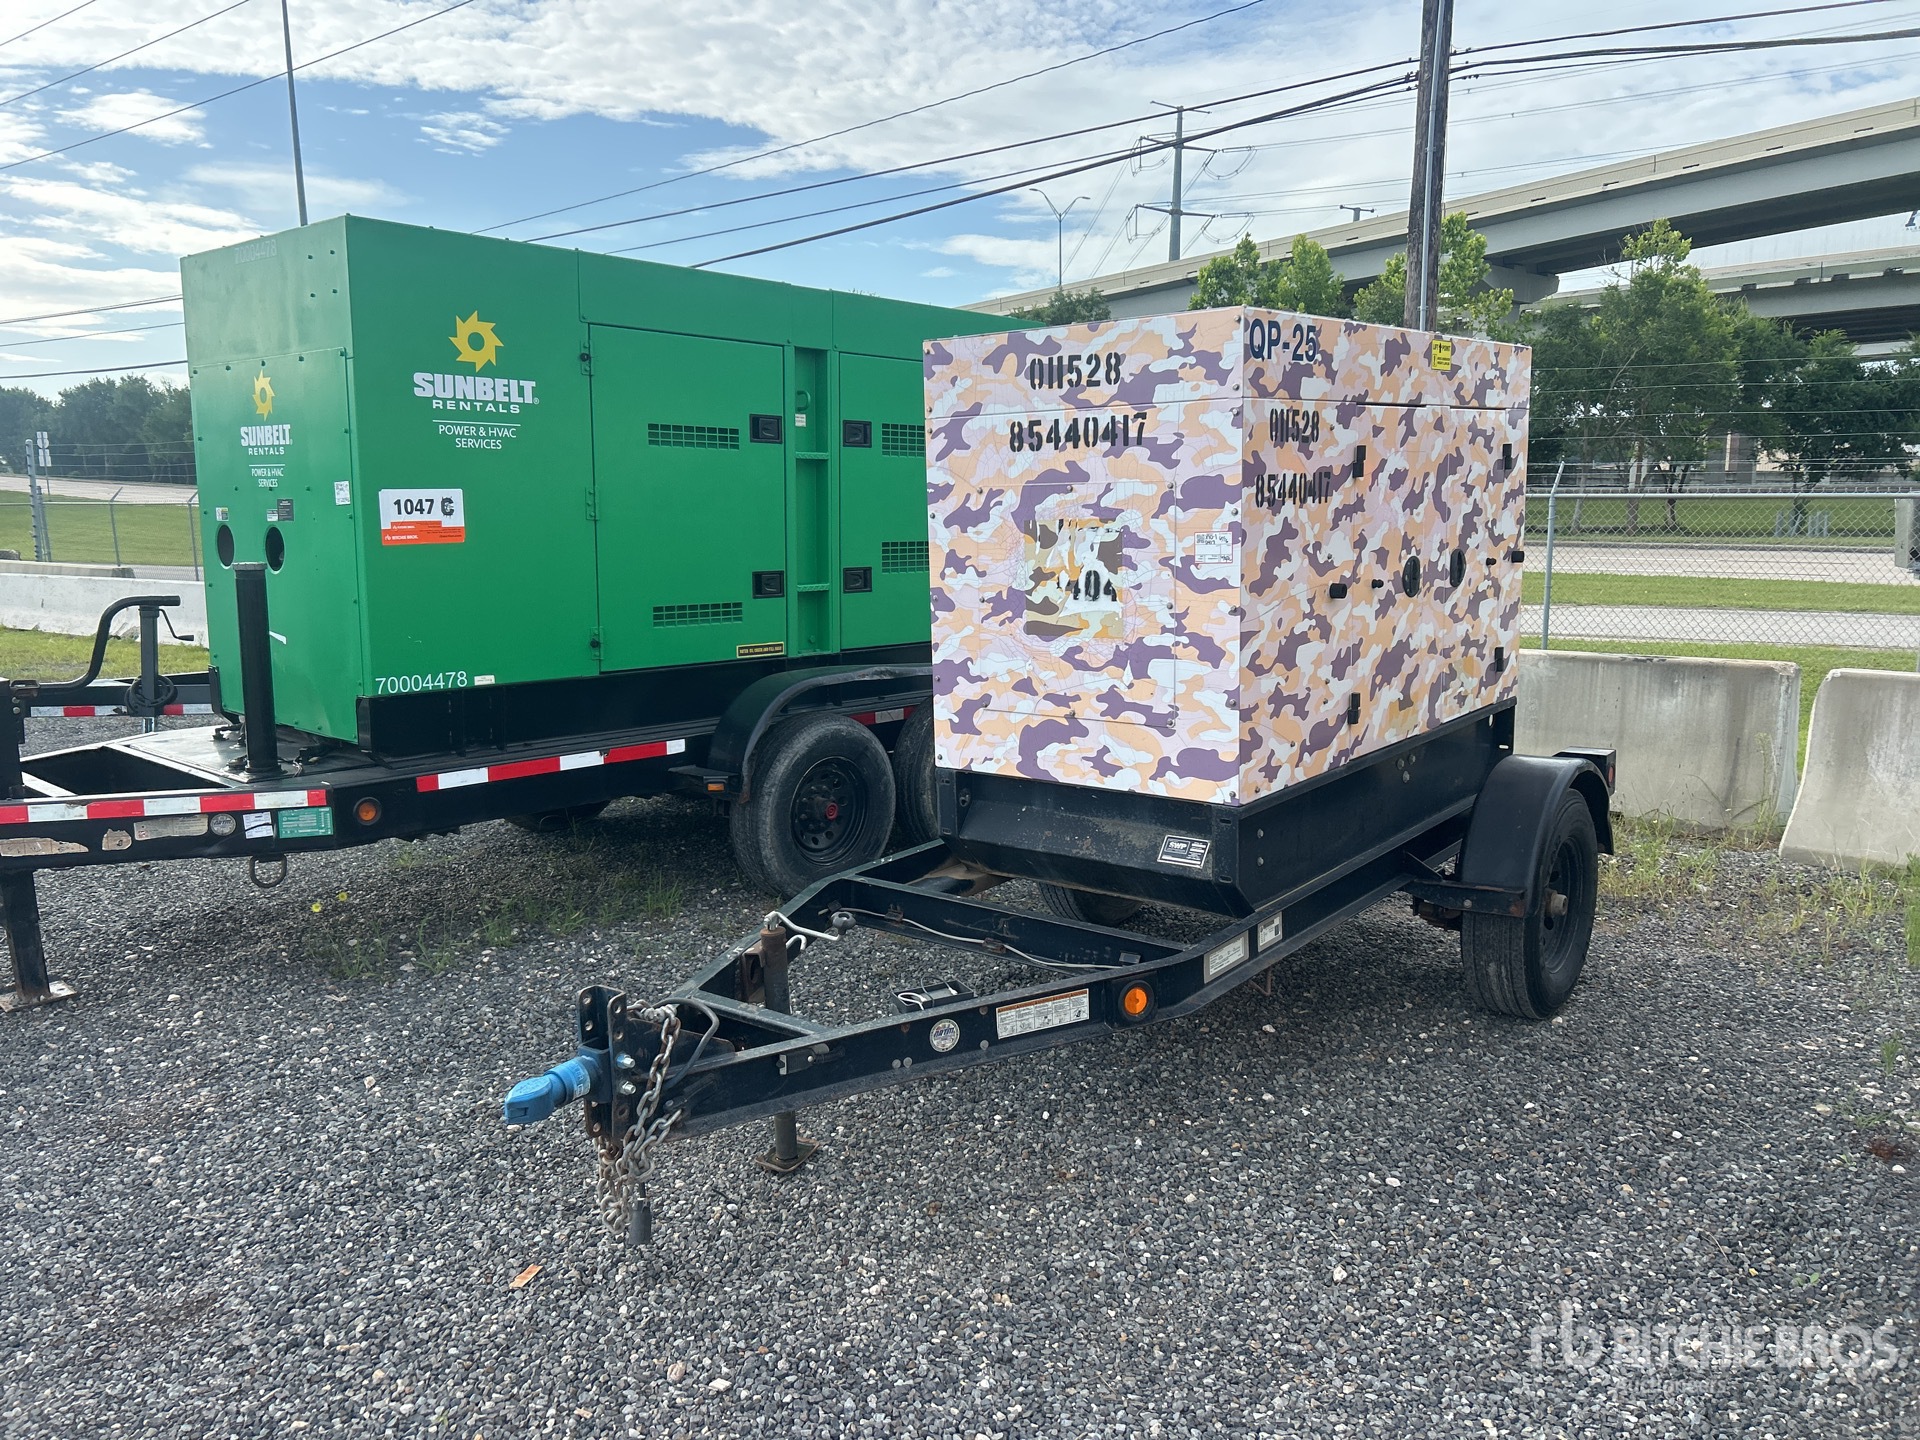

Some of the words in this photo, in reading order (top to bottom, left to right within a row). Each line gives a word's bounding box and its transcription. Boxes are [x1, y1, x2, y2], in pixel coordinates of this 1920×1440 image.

[1249, 318, 1317, 362] QP-25
[413, 372, 537, 404] SUNBELT
[432, 399, 521, 414] RENTALS
[240, 424, 291, 447] SUNBELT
[438, 424, 477, 437] POWER
[478, 427, 487, 437] &
[488, 426, 517, 438] HVAC
[1009, 412, 1148, 453] 85440417
[248, 446, 285, 456] RENTALS
[455, 438, 502, 450] SERVICES
[251, 468, 267, 477] POWER
[258, 478, 278, 488] SERVICES
[1255, 471, 1331, 508] 85440417
[393, 498, 435, 516] 1047
[375, 670, 468, 695] 70004478
[1169, 841, 1187, 850] SWP
